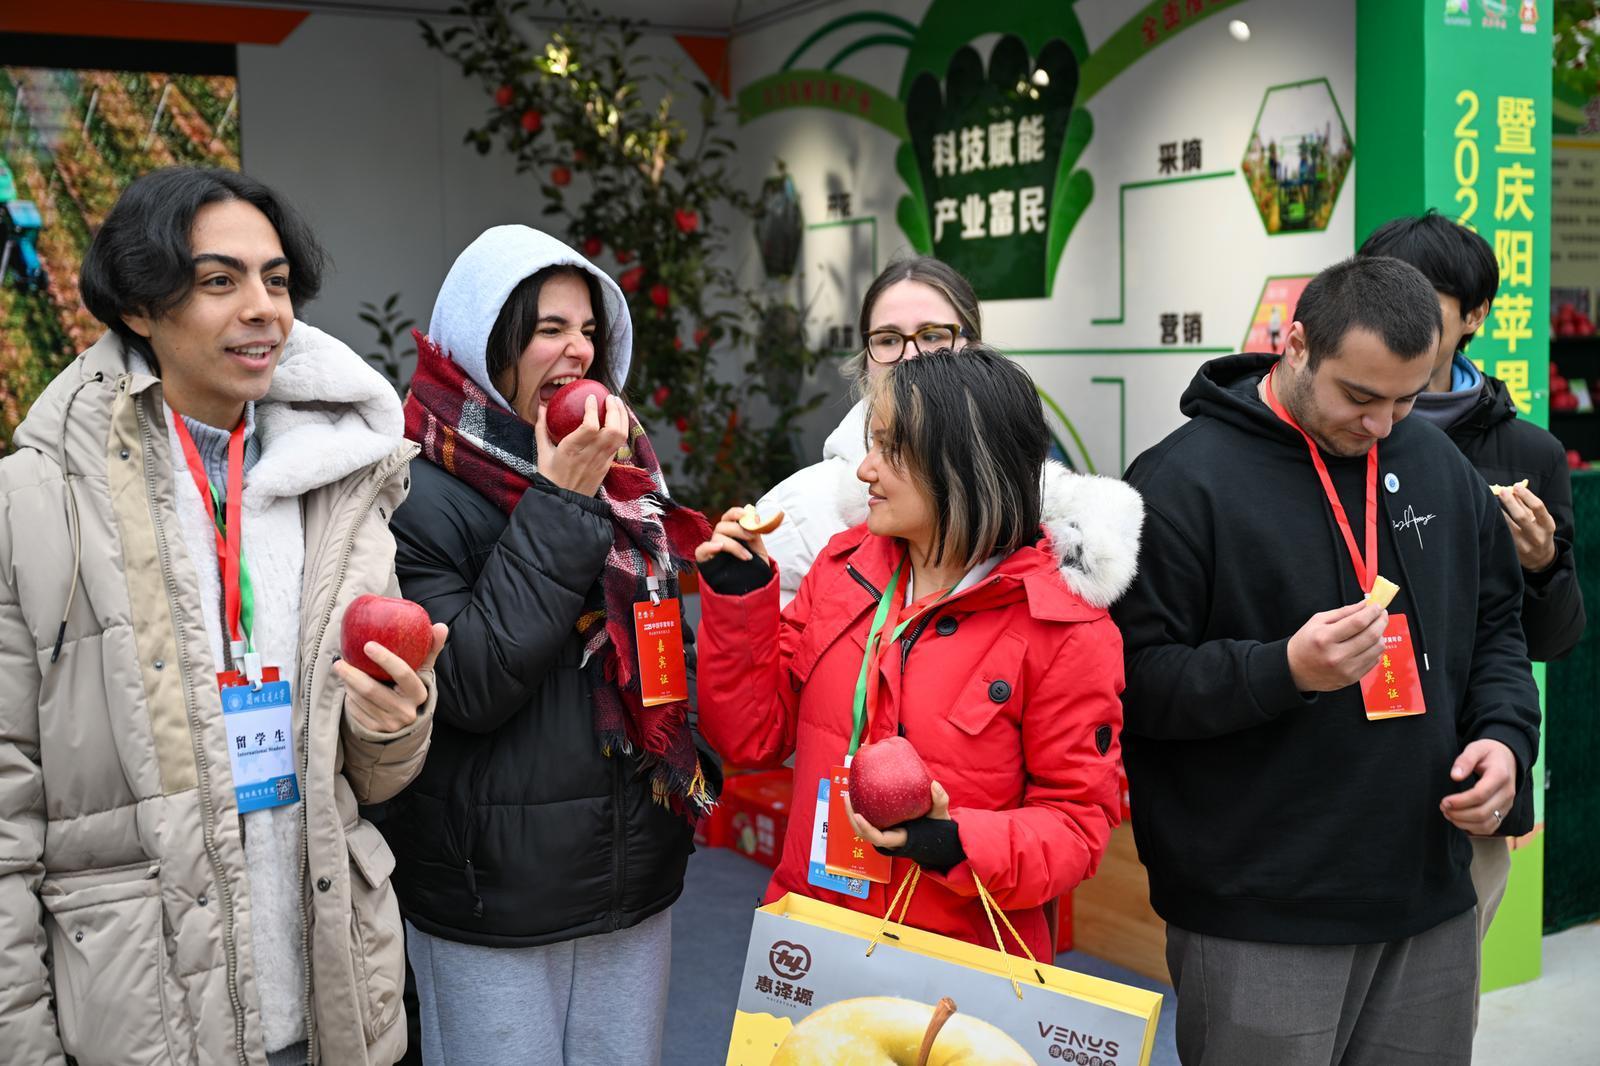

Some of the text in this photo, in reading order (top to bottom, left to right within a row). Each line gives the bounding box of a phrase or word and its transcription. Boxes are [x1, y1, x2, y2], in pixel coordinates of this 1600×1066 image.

[933, 115, 1046, 177] 科技赋能
[1158, 138, 1203, 175] 采摘
[933, 187, 1047, 242] 产业富民
[1493, 96, 1536, 415] 暨庆阳苹果
[1160, 313, 1203, 345] 营销
[1382, 654, 1399, 700] 嘉宾证
[236, 729, 286, 750] 留学生
[237, 748, 268, 758] International
[755, 975, 815, 1007] 惠泽塬
[1038, 1021, 1120, 1058] VENUS
